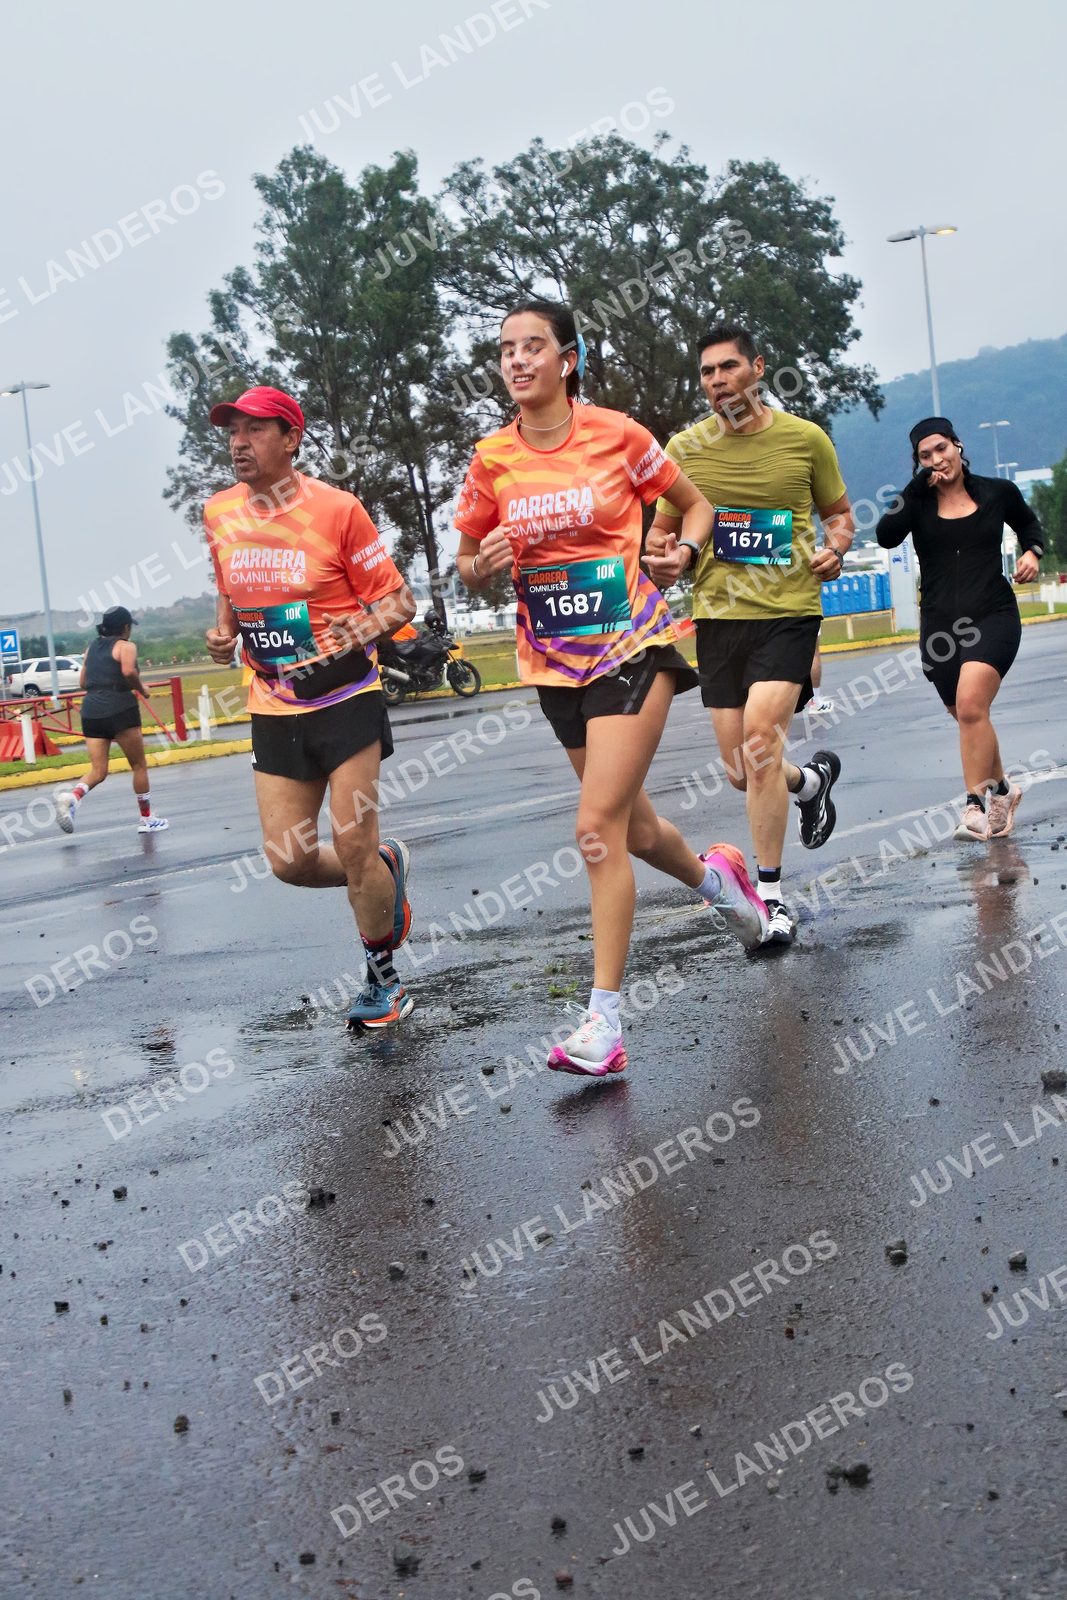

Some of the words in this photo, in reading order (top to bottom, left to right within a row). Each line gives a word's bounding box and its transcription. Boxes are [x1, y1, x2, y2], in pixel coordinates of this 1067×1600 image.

[508, 486, 594, 522] CARRERA
[718, 512, 752, 523] CARRERA
[771, 514, 787, 526] 10K
[728, 531, 773, 549] 1671
[230, 547, 306, 570] CARRERA
[527, 570, 569, 585] CARRERA
[596, 563, 616, 580] 10K
[545, 591, 603, 617] 1687
[285, 607, 302, 621] 10K
[249, 629, 295, 649] 1504
